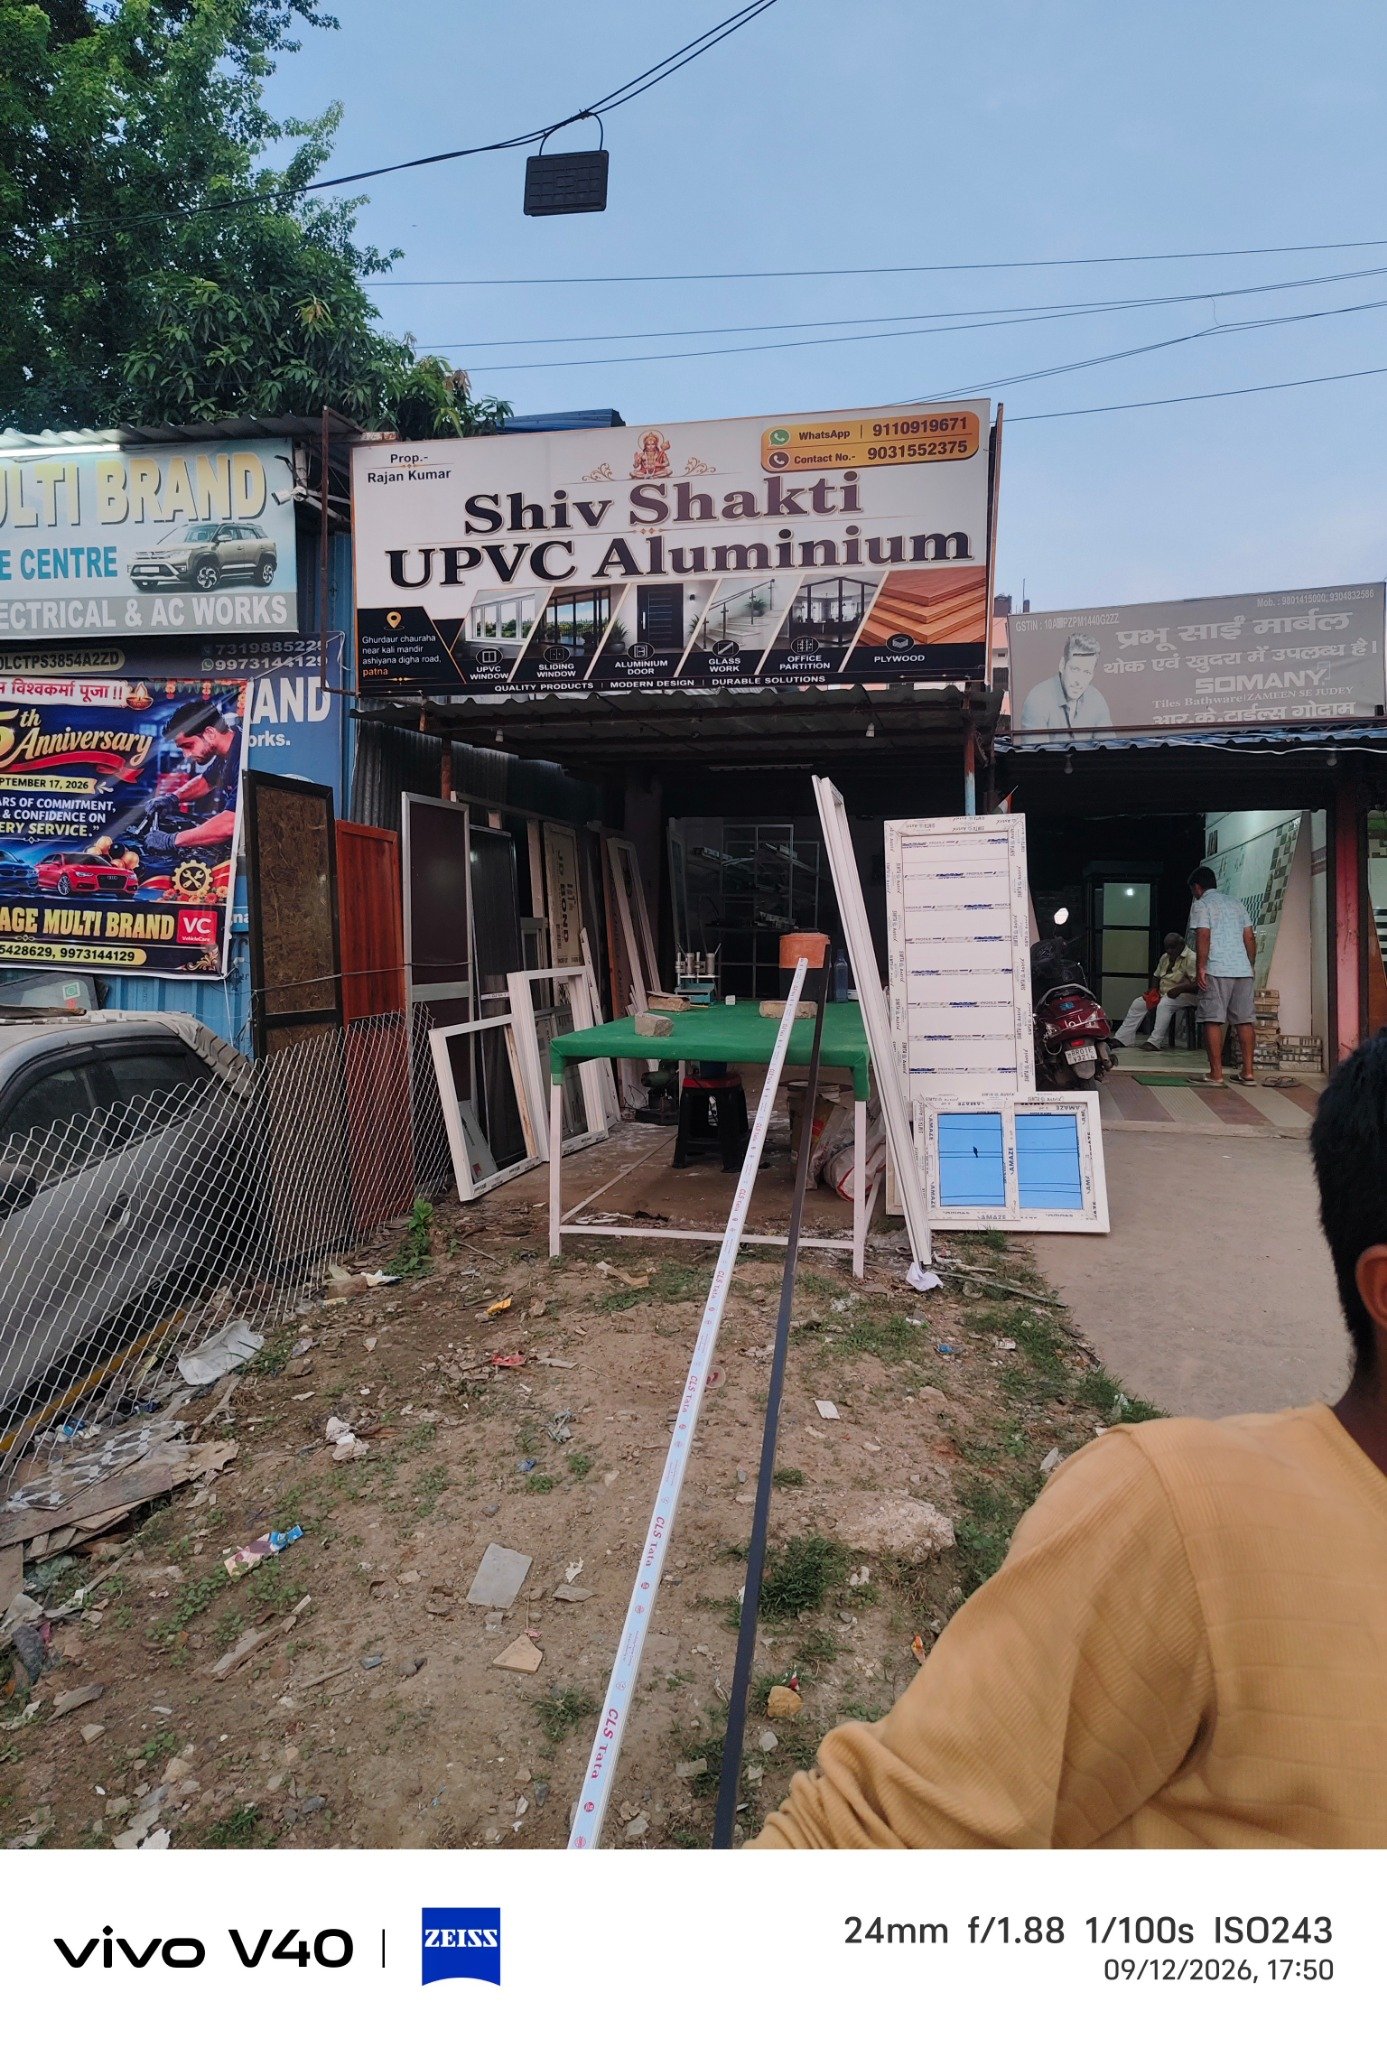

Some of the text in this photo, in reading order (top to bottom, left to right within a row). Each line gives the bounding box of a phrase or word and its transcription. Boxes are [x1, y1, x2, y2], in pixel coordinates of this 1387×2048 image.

[798, 416, 968, 441] WhatsApp 9110919671
[794, 452, 833, 465] Contact
[867, 440, 968, 460] 9031552375
[367, 469, 452, 484] Rajan Kumar
[95, 452, 267, 525] BRAND
[464, 470, 863, 536] Shiv Shakti
[20, 546, 118, 580] CENTRE
[385, 525, 975, 590] UPVC Aluminium
[124, 599, 142, 627] &
[151, 598, 185, 627] AC
[192, 595, 288, 626] WORKS
[1252, 607, 1354, 635] मार्बल
[362, 634, 436, 645] Ghurdaur chauraha
[362, 645, 423, 654] near kali mandir
[362, 656, 397, 666] ashiyana
[398, 655, 420, 665] digha
[615, 660, 668, 668] ALUMINIUM
[708, 657, 741, 666] GLASS
[787, 655, 822, 663] OFFICE
[874, 654, 925, 663] PLYWOOD
[1185, 651, 1243, 673] खुदरा
[1247, 646, 1269, 662] में
[362, 667, 388, 677] patna
[476, 664, 501, 673] UPVC
[536, 670, 576, 678] WINDOW
[538, 663, 575, 671] SLIDING
[627, 667, 655, 675] DOOR
[709, 665, 740, 673] WORK
[779, 662, 831, 671] PARTITION
[469, 673, 509, 681] WINDOW
[610, 679, 695, 689] MODERN DESIGN
[712, 675, 826, 686] DURABLE SOLUTIONS
[1195, 668, 1328, 695] SOMANY
[12, 678, 76, 697] विश्वकर्मा
[79, 683, 110, 702] पूजा
[494, 682, 594, 692] QUALITY PRODUCTS
[1152, 699, 1181, 709] Tiles
[1185, 695, 1243, 706] Bathware
[0, 726, 154, 768] Anniversary
[65, 780, 89, 789] 2026
[0, 796, 116, 813] RS OF COMMITMENT,
[2, 808, 106, 823] & CONFIDENCE ON
[42, 908, 103, 937] MULTI
[105, 911, 175, 940] BRAND
[183, 917, 212, 935] VC
[60, 947, 135, 963] 9973144129
[681, 1375, 698, 1413] CLS Tata
[644, 1516, 666, 1567] CLS Tata
[591, 1708, 619, 1779] CLS Tata
